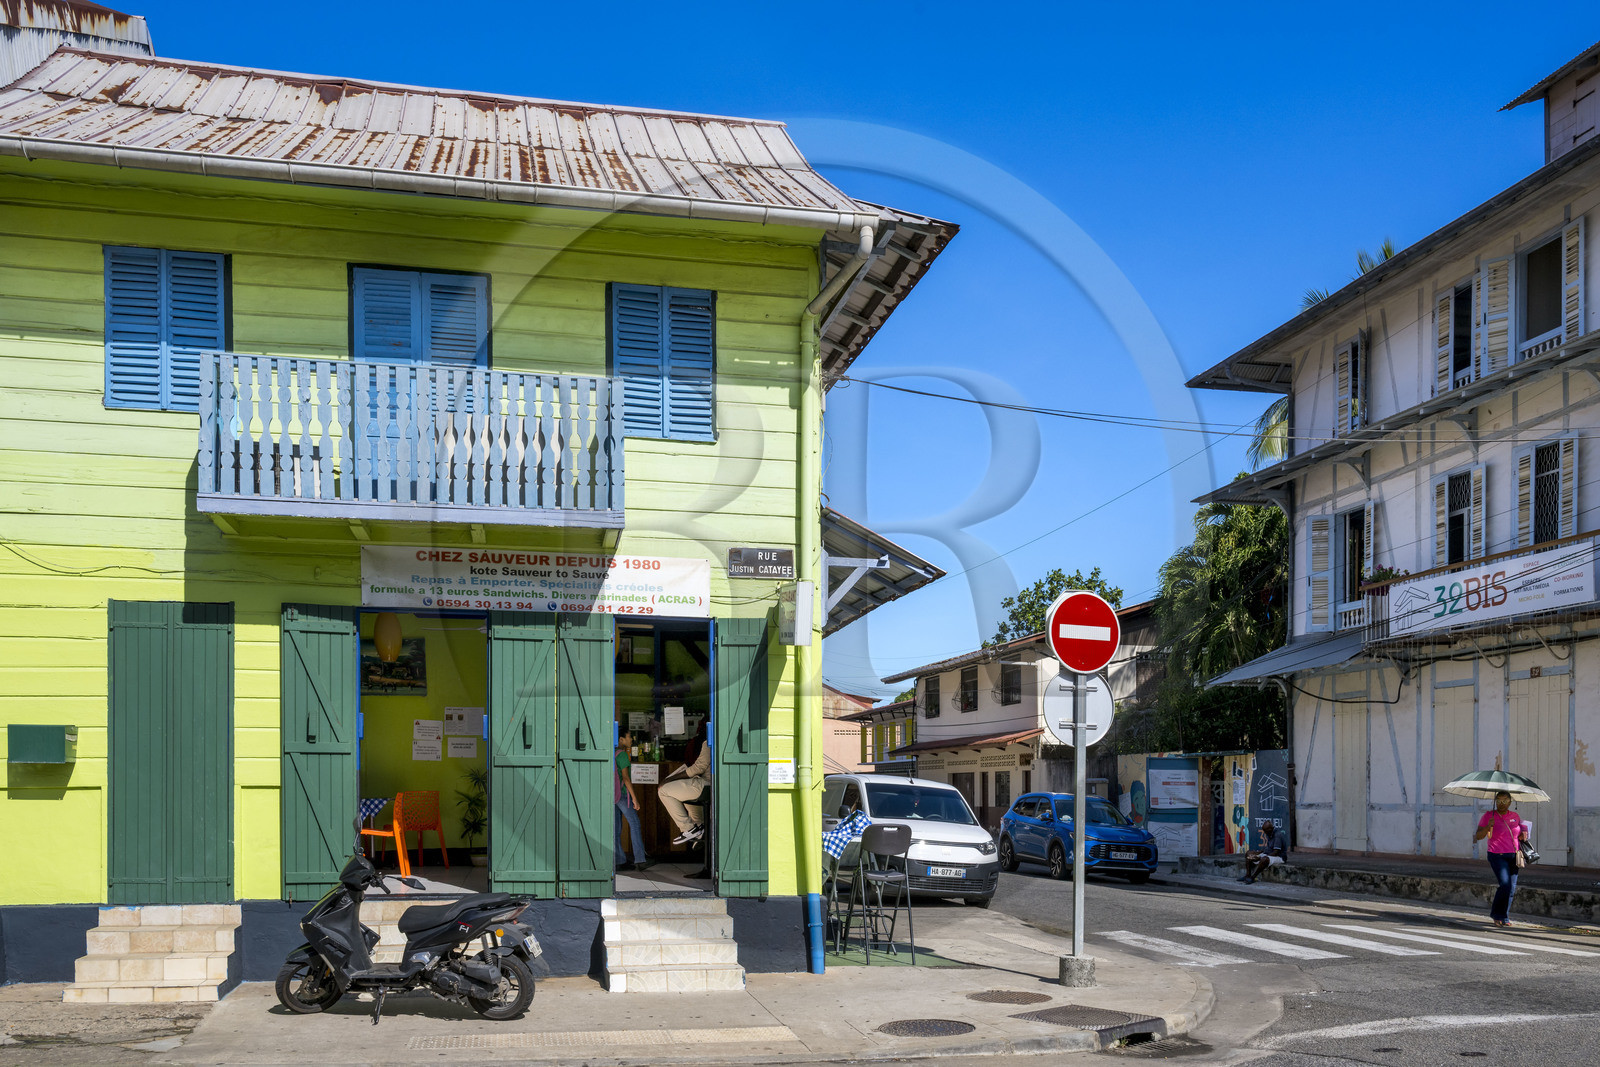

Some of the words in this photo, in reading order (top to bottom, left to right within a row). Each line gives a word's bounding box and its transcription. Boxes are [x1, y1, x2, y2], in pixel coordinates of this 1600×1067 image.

[416, 550, 463, 563] CHEZ
[468, 552, 552, 566] SAUVEUR
[556, 555, 617, 569] DEPUIS
[623, 559, 661, 570] 1980
[758, 552, 778, 560] RUE
[470, 566, 498, 576] kote
[502, 566, 552, 578] Sauveur
[556, 570, 568, 578] to
[572, 569, 610, 580] Sauvé
[729, 564, 754, 574] JUSTIN
[758, 565, 792, 575] CATAYEE
[411, 574, 453, 586] Repas
[458, 576, 467, 585] à
[471, 576, 535, 588] Emporter.
[540, 579, 612, 591] Spécialités
[616, 582, 664, 592] créoles
[370, 585, 415, 594] formule
[430, 586, 444, 596] 13
[446, 588, 479, 597] euros
[482, 588, 548, 599] Sandwichs.
[552, 590, 586, 600] Divers
[590, 593, 648, 602] marinades
[658, 595, 696, 604] ACRAS
[1554, 586, 1584, 596] FORMATIONS
[436, 600, 470, 608] 0594
[516, 602, 533, 610] 94
[561, 604, 594, 612] 0694
[598, 605, 612, 613] 91
[618, 606, 634, 614] 42
[638, 606, 654, 614] 29
